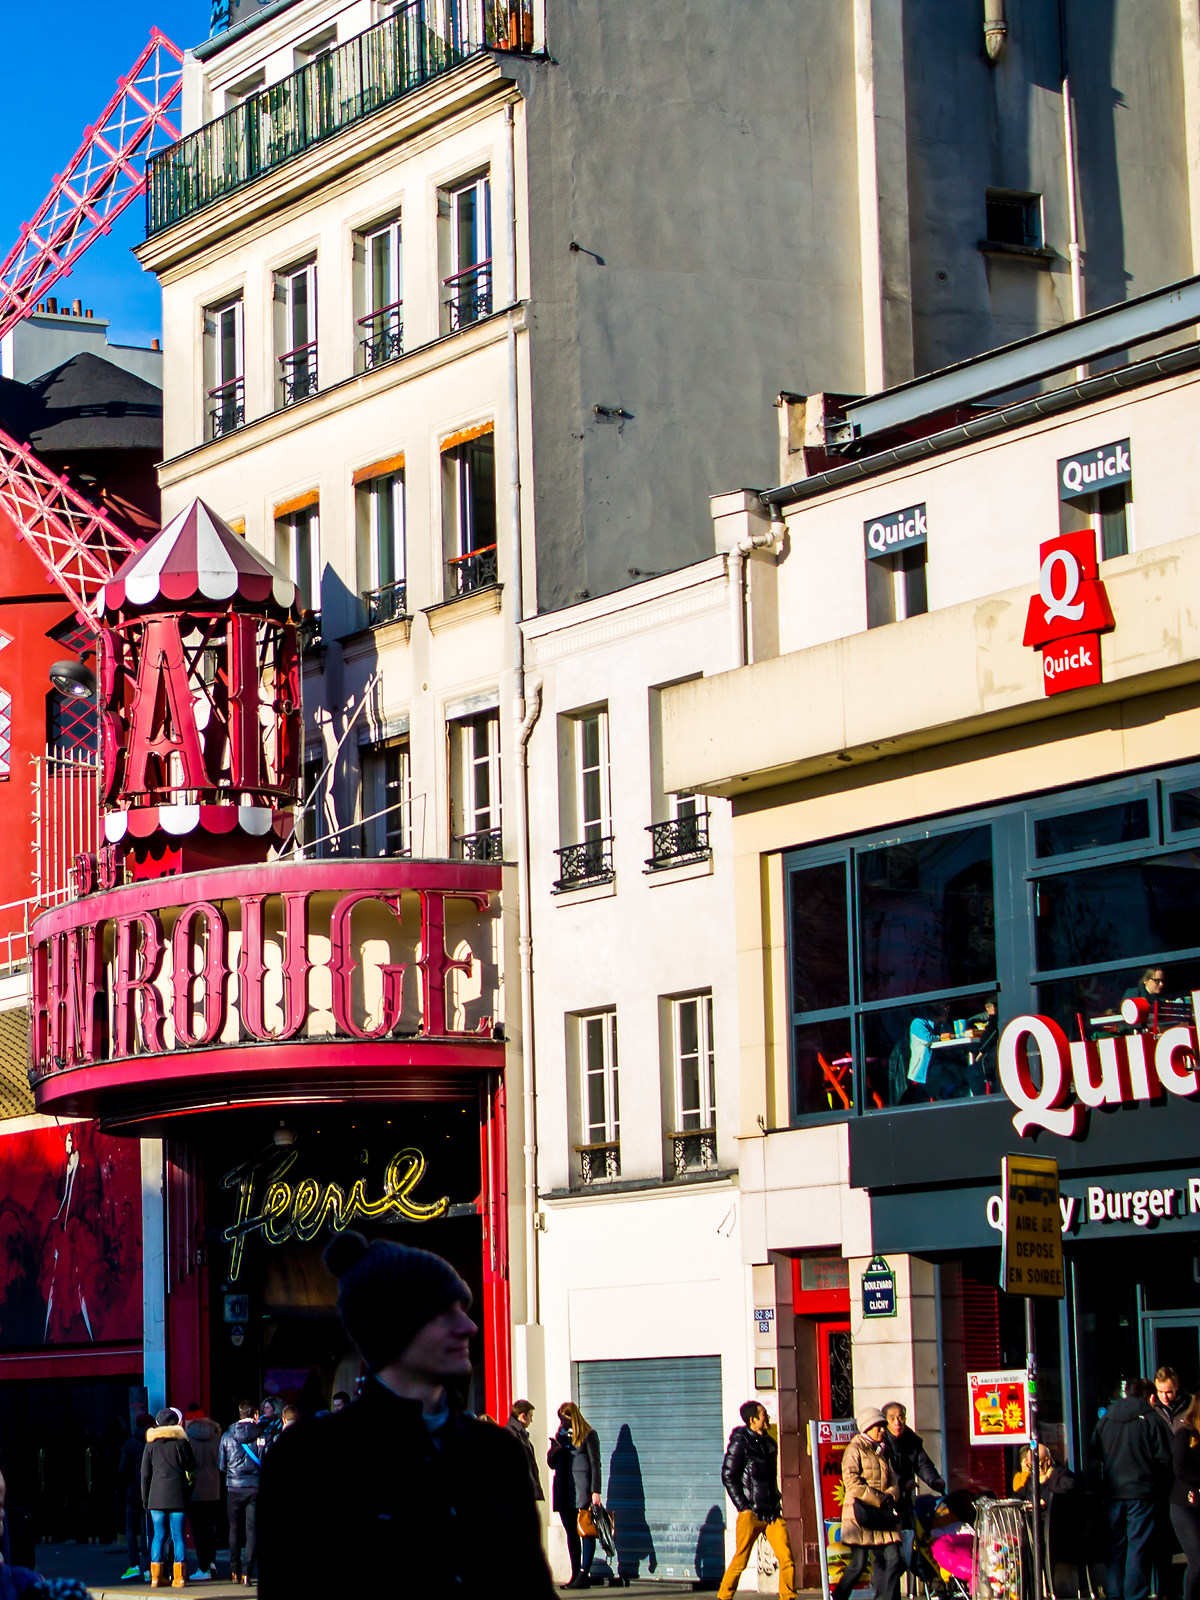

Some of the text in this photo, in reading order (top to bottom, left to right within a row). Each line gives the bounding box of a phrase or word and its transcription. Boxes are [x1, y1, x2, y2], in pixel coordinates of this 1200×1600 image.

[1062, 446, 1131, 493] Quick
[868, 509, 927, 552] Quick
[1039, 549, 1085, 625] Q
[1043, 647, 1092, 680] Quick
[113, 889, 494, 1058] ROUGE
[999, 988, 1200, 1138] Quic
[1088, 1186, 1174, 1226] Burger
[1015, 1215, 1054, 1233] AIRE DE
[1017, 1242, 1055, 1258] DEPOSE
[864, 1279, 893, 1291] BOULEVARD
[1009, 1267, 1022, 1283] EN
[755, 1310, 774, 1320] 82 84
[869, 1300, 889, 1310] CLICHY
[760, 1322, 769, 1332] 86
